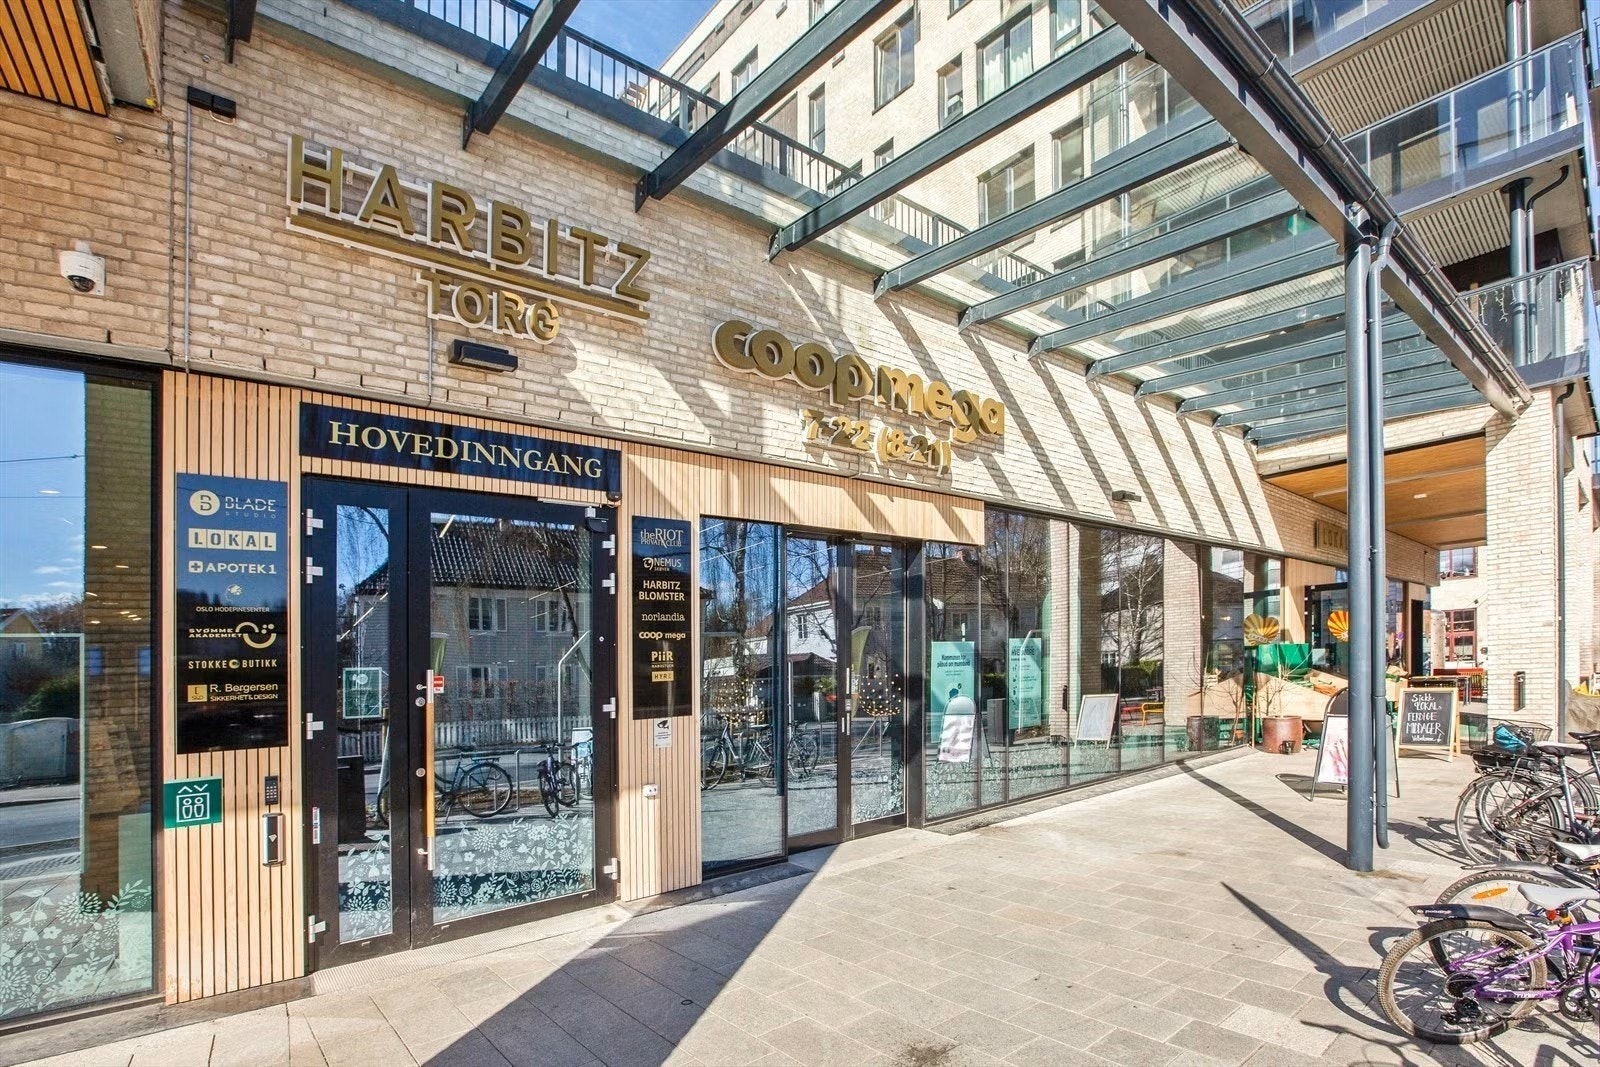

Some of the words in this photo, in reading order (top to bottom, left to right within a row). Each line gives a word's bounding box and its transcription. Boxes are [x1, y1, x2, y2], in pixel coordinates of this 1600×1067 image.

[288, 134, 650, 302] HARBITZ
[417, 270, 560, 344] TORG
[712, 320, 873, 408] coop
[875, 364, 1004, 444] mega
[801, 408, 871, 451] 7-22
[873, 426, 951, 475] (8-21)
[328, 420, 602, 478] HOVEDINNGANG
[225, 496, 276, 512] BLADE
[225, 511, 276, 519] STUDIO
[194, 532, 273, 548] LOKAL
[205, 562, 267, 574] APOTEK
[654, 557, 682, 568] NEMUS
[643, 580, 681, 590] HARBITZ
[639, 591, 685, 601] BLOMSTER
[641, 612, 686, 621] norlandia
[639, 631, 663, 640] coop
[651, 651, 674, 661] PiiR
[188, 660, 227, 669] STOKKE
[242, 659, 277, 668] BUTIKK
[209, 684, 222, 693] R.
[225, 683, 279, 694] Bergersen
